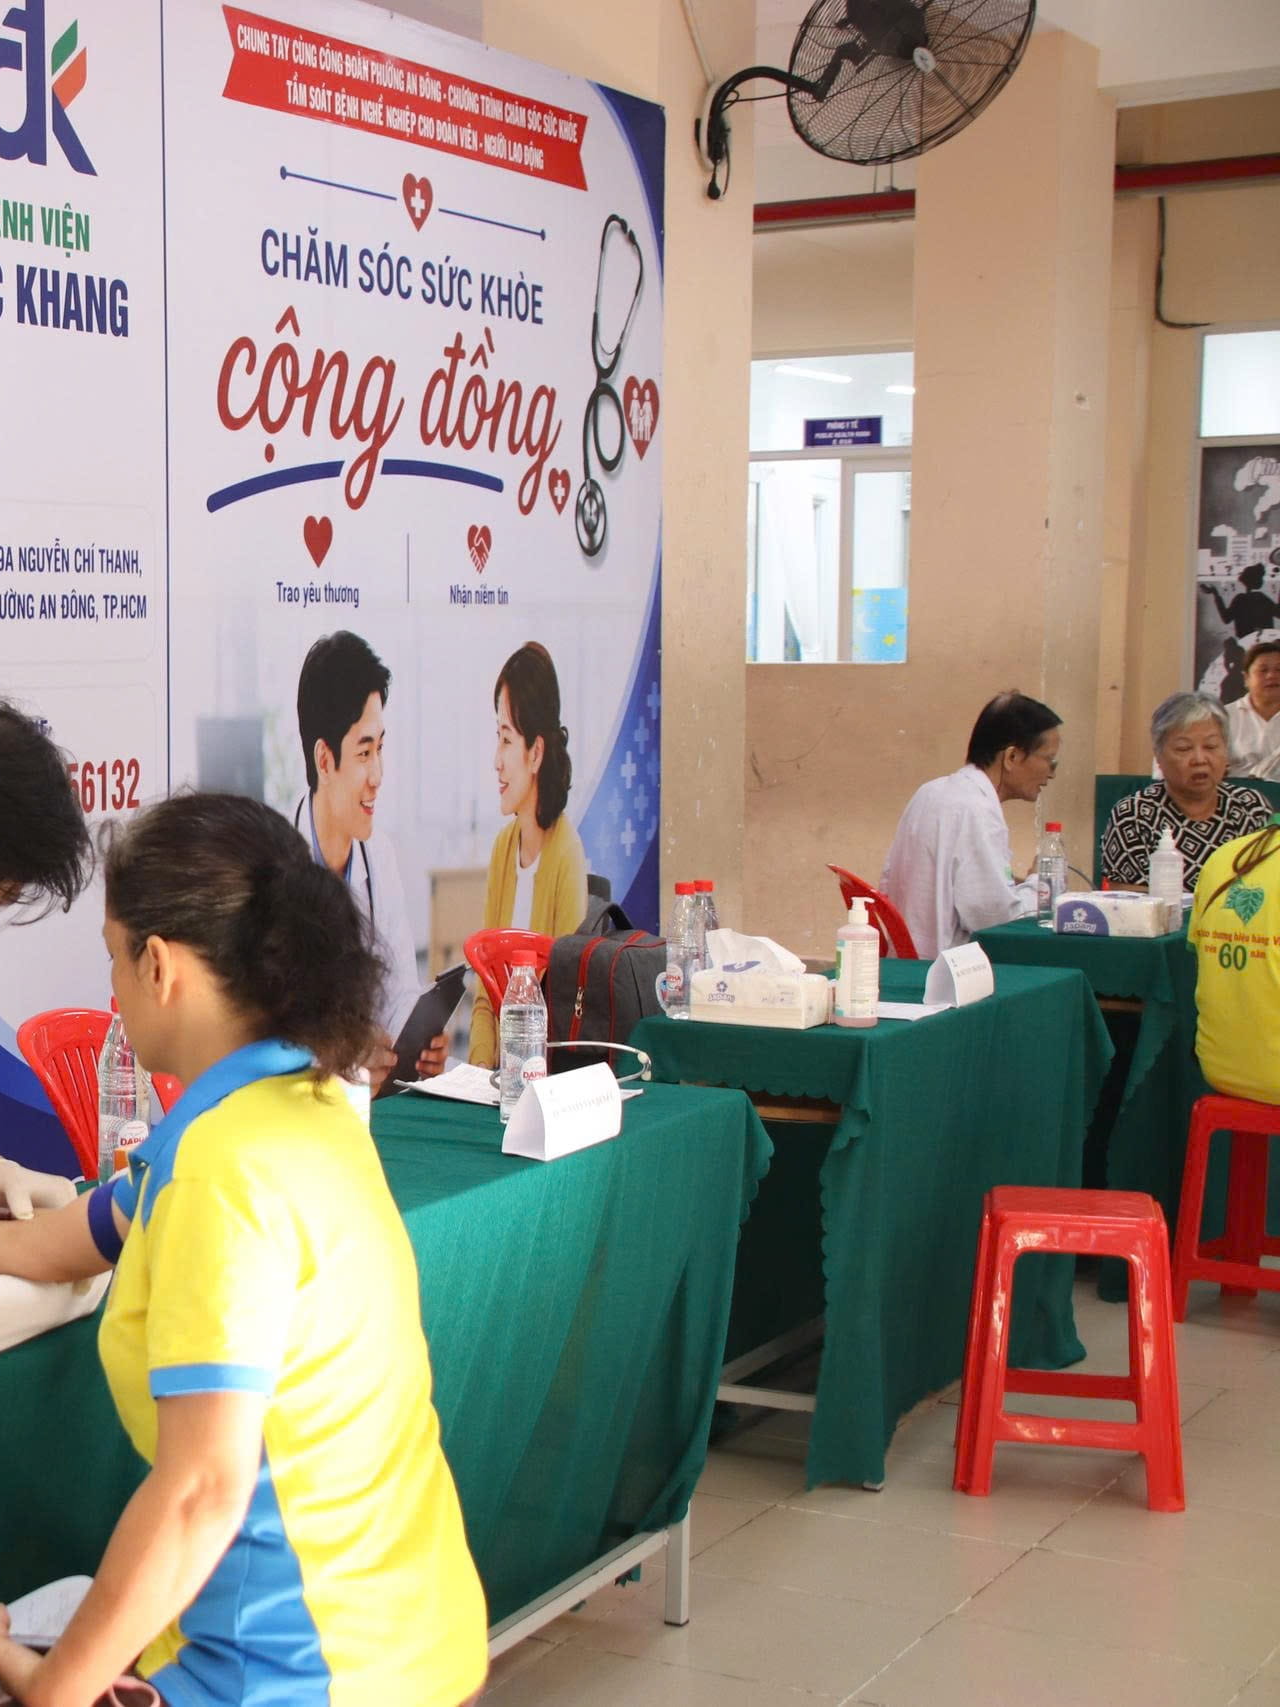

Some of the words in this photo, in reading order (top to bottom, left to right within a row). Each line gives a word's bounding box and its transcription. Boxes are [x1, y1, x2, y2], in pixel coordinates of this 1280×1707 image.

[237, 23, 270, 56] CHUNG
[272, 34, 290, 61] TAY
[292, 35, 318, 69] CÙNG
[320, 42, 344, 75] CÔNG
[344, 51, 369, 82] ĐOÀN
[370, 57, 405, 91] PHƯỜNG
[406, 74, 418, 95] AN
[419, 72, 442, 103] ĐÔNG
[448, 84, 479, 115] CHƯƠNG
[481, 91, 503, 121] TRÌNH
[504, 101, 526, 128] CHĂM
[527, 104, 542, 133] SÓC
[543, 109, 558, 138] SỨC
[309, 82, 332, 113] SOÁT
[335, 87, 359, 121] BỆNH
[361, 93, 384, 126] NGHỀ
[386, 104, 417, 137] NGHIỆP
[418, 112, 435, 139] CHO
[436, 116, 458, 146] ĐOÀN
[460, 123, 478, 151] VIÊN
[508, 140, 523, 164] LAO
[523, 141, 545, 171] ĐỘNG
[40, 202, 90, 258] VIỆN
[261, 226, 348, 289] CHĂM
[358, 242, 413, 299] SÓC
[421, 255, 472, 311] SỨC
[16, 263, 129, 338] KHANG
[216, 304, 405, 510] cộng
[419, 326, 562, 516] đồng
[18, 538, 70, 574] NGUYỄN
[74, 543, 95, 574] CHÍ
[99, 548, 143, 577] THANH,
[39, 595, 57, 619] AN
[61, 589, 99, 622] ĐÔNG,
[103, 595, 147, 619] TP.HCM
[276, 581, 300, 603] Trao
[303, 582, 321, 608] yêu
[324, 582, 360, 609] thương
[449, 584, 472, 608] Nhận
[475, 583, 495, 604] niềm
[497, 586, 509, 604] tin
[1218, 943, 1247, 971] 60
